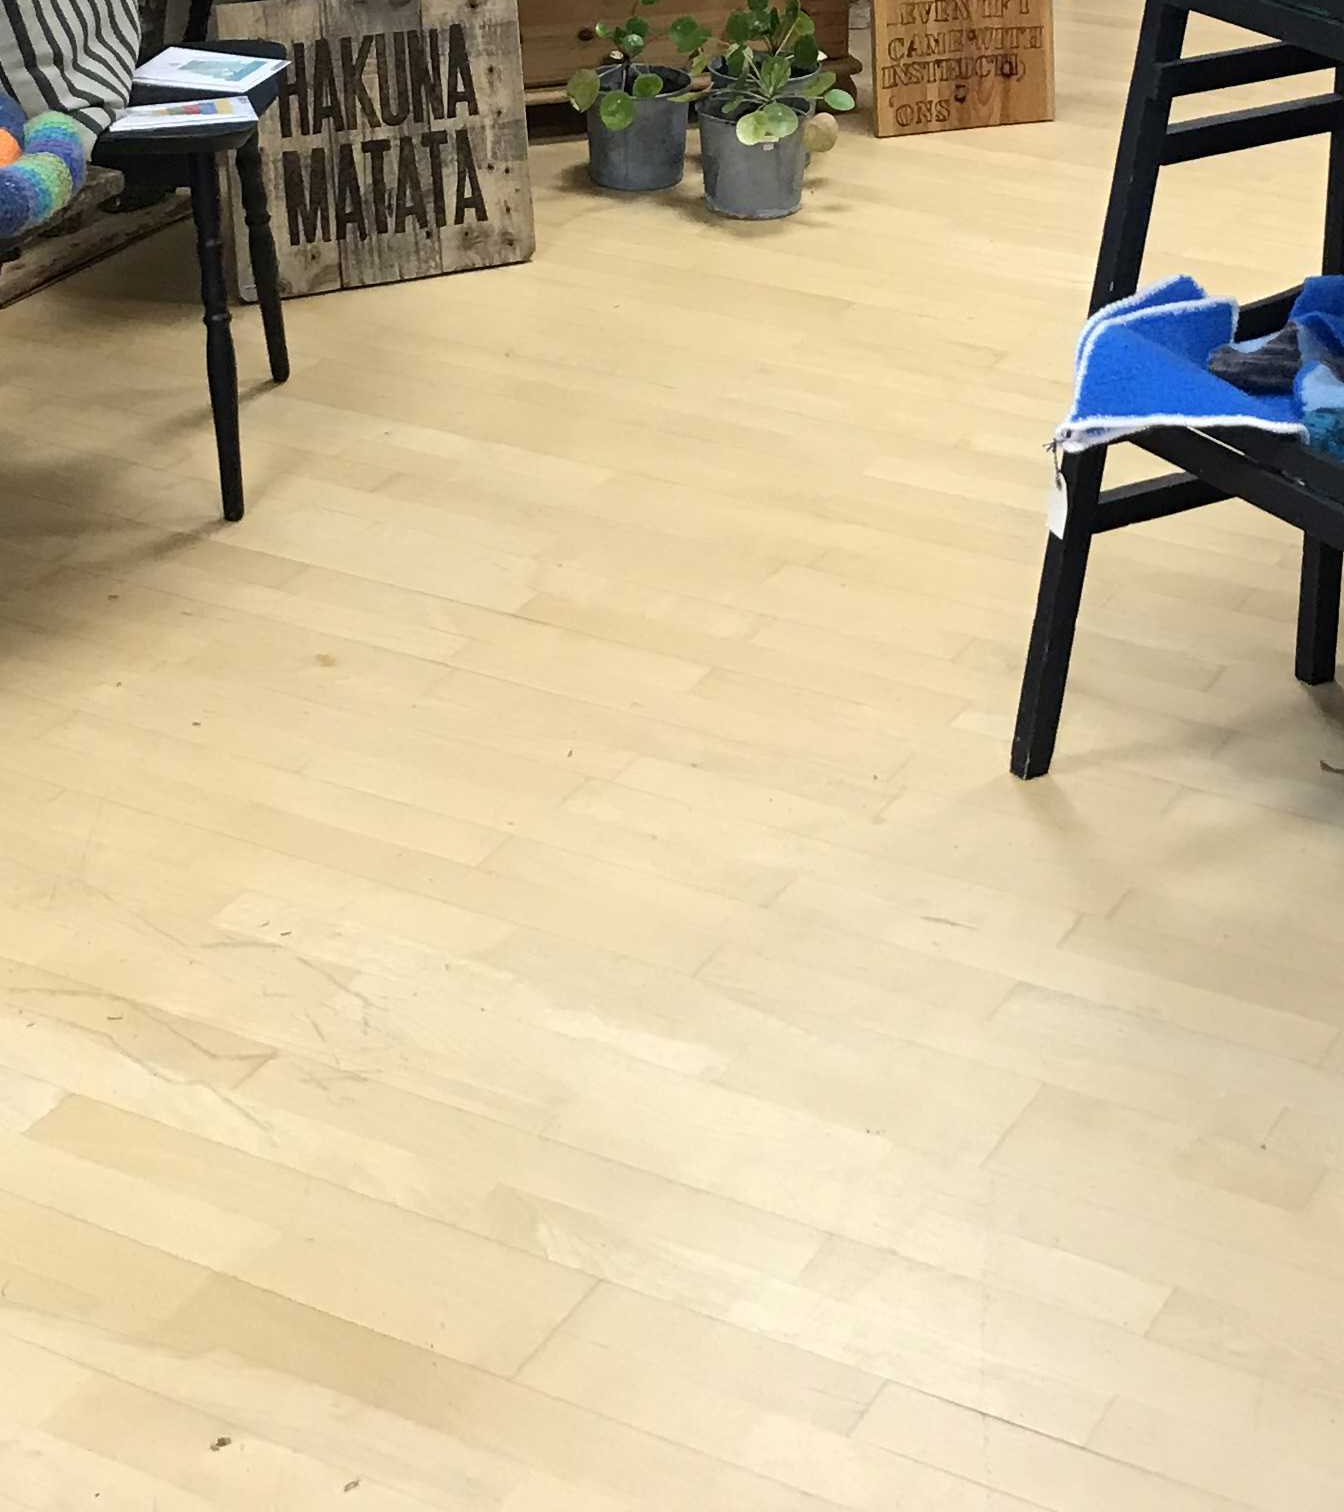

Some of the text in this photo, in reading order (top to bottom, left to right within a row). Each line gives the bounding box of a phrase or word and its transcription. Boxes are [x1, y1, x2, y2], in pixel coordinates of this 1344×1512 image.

[278, 23, 480, 139] HAKUNA
[887, 25, 1045, 62] CAME WITH
[281, 128, 489, 246] MATATA
